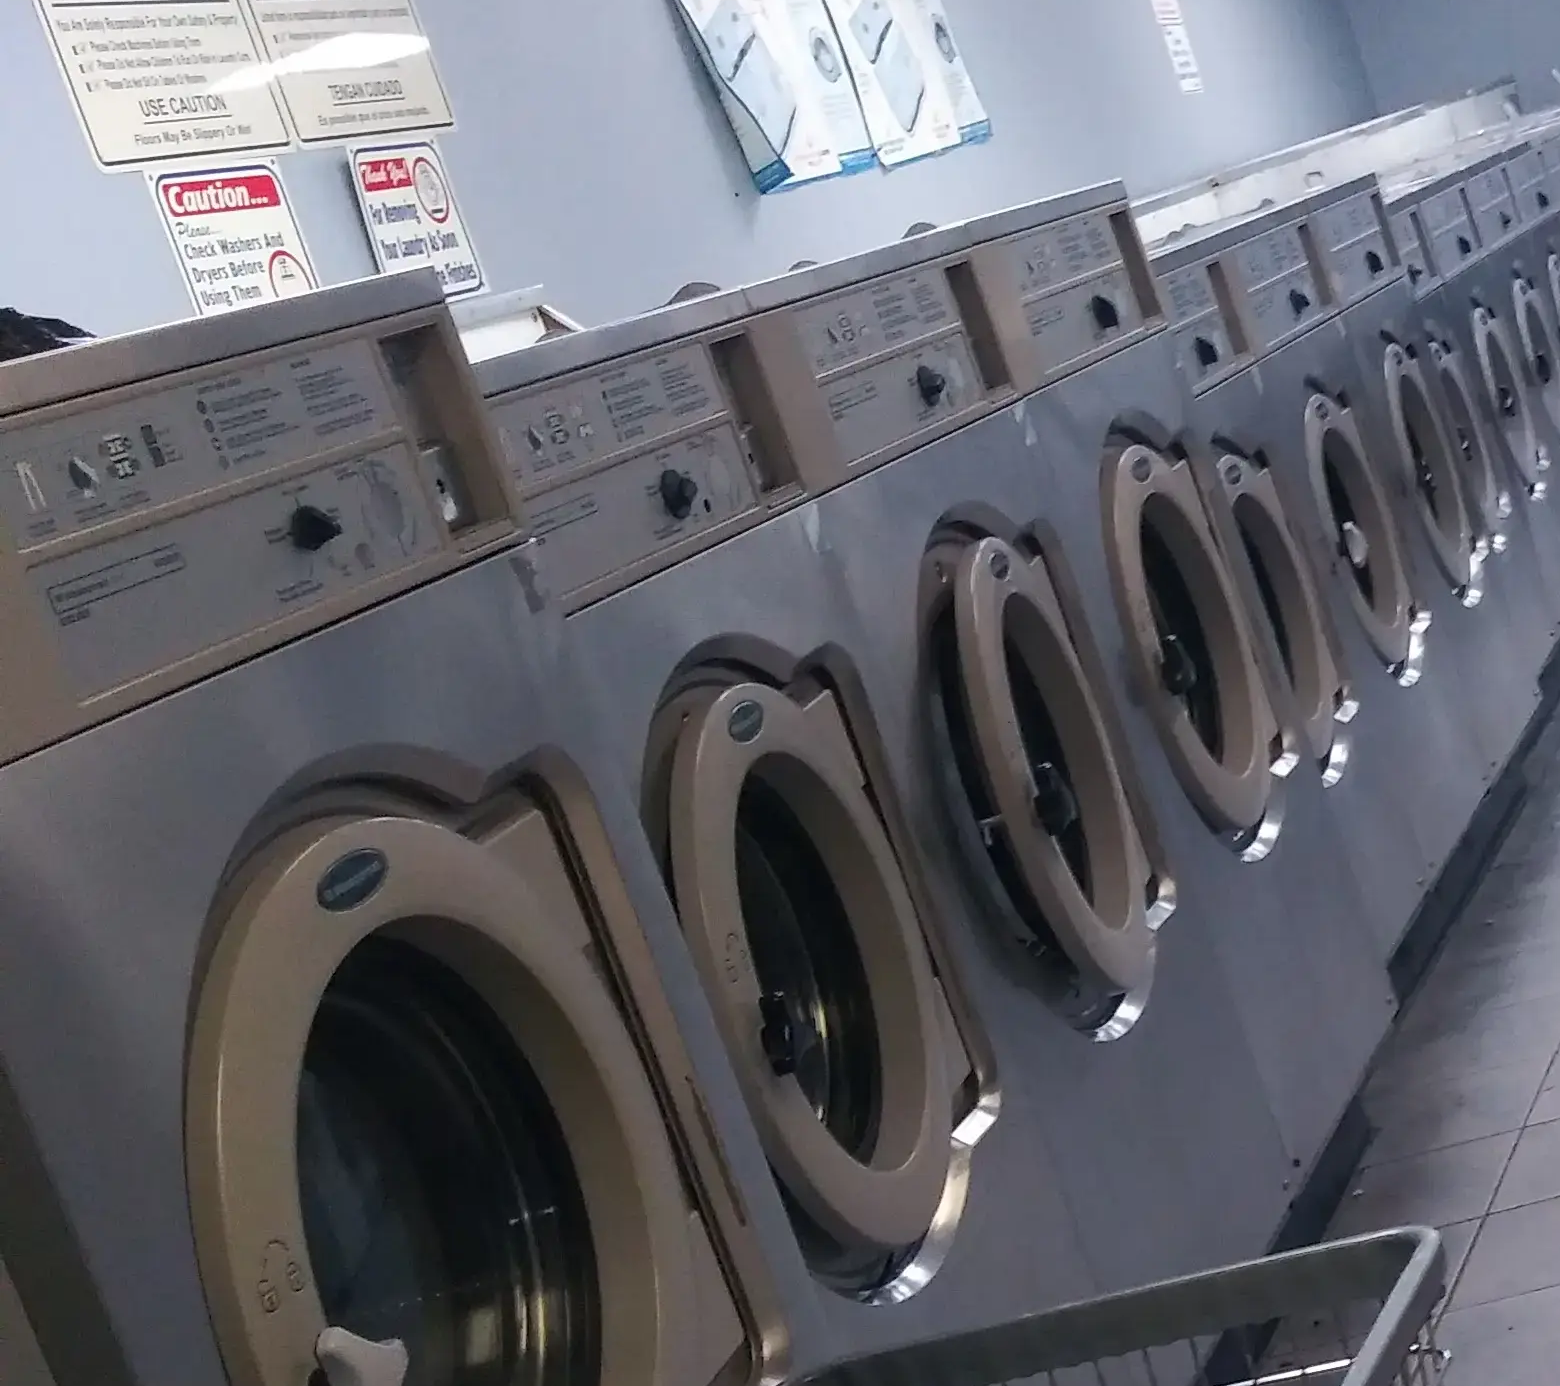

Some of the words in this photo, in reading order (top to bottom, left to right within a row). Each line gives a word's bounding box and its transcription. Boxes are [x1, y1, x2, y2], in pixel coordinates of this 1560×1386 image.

[137, 97, 169, 117] USE
[168, 94, 228, 115] CAUTION
[134, 133, 163, 145] Floors
[163, 131, 181, 144] May
[180, 129, 193, 141] Be
[193, 126, 226, 141] Slippery
[167, 181, 269, 214] Caution...
[368, 203, 384, 226] For
[183, 242, 219, 261] Check
[216, 235, 263, 255] Washers
[263, 231, 286, 249] And
[191, 265, 230, 286] Dryers
[228, 259, 266, 279] Before
[199, 288, 234, 308] Using
[230, 285, 263, 302] Them
